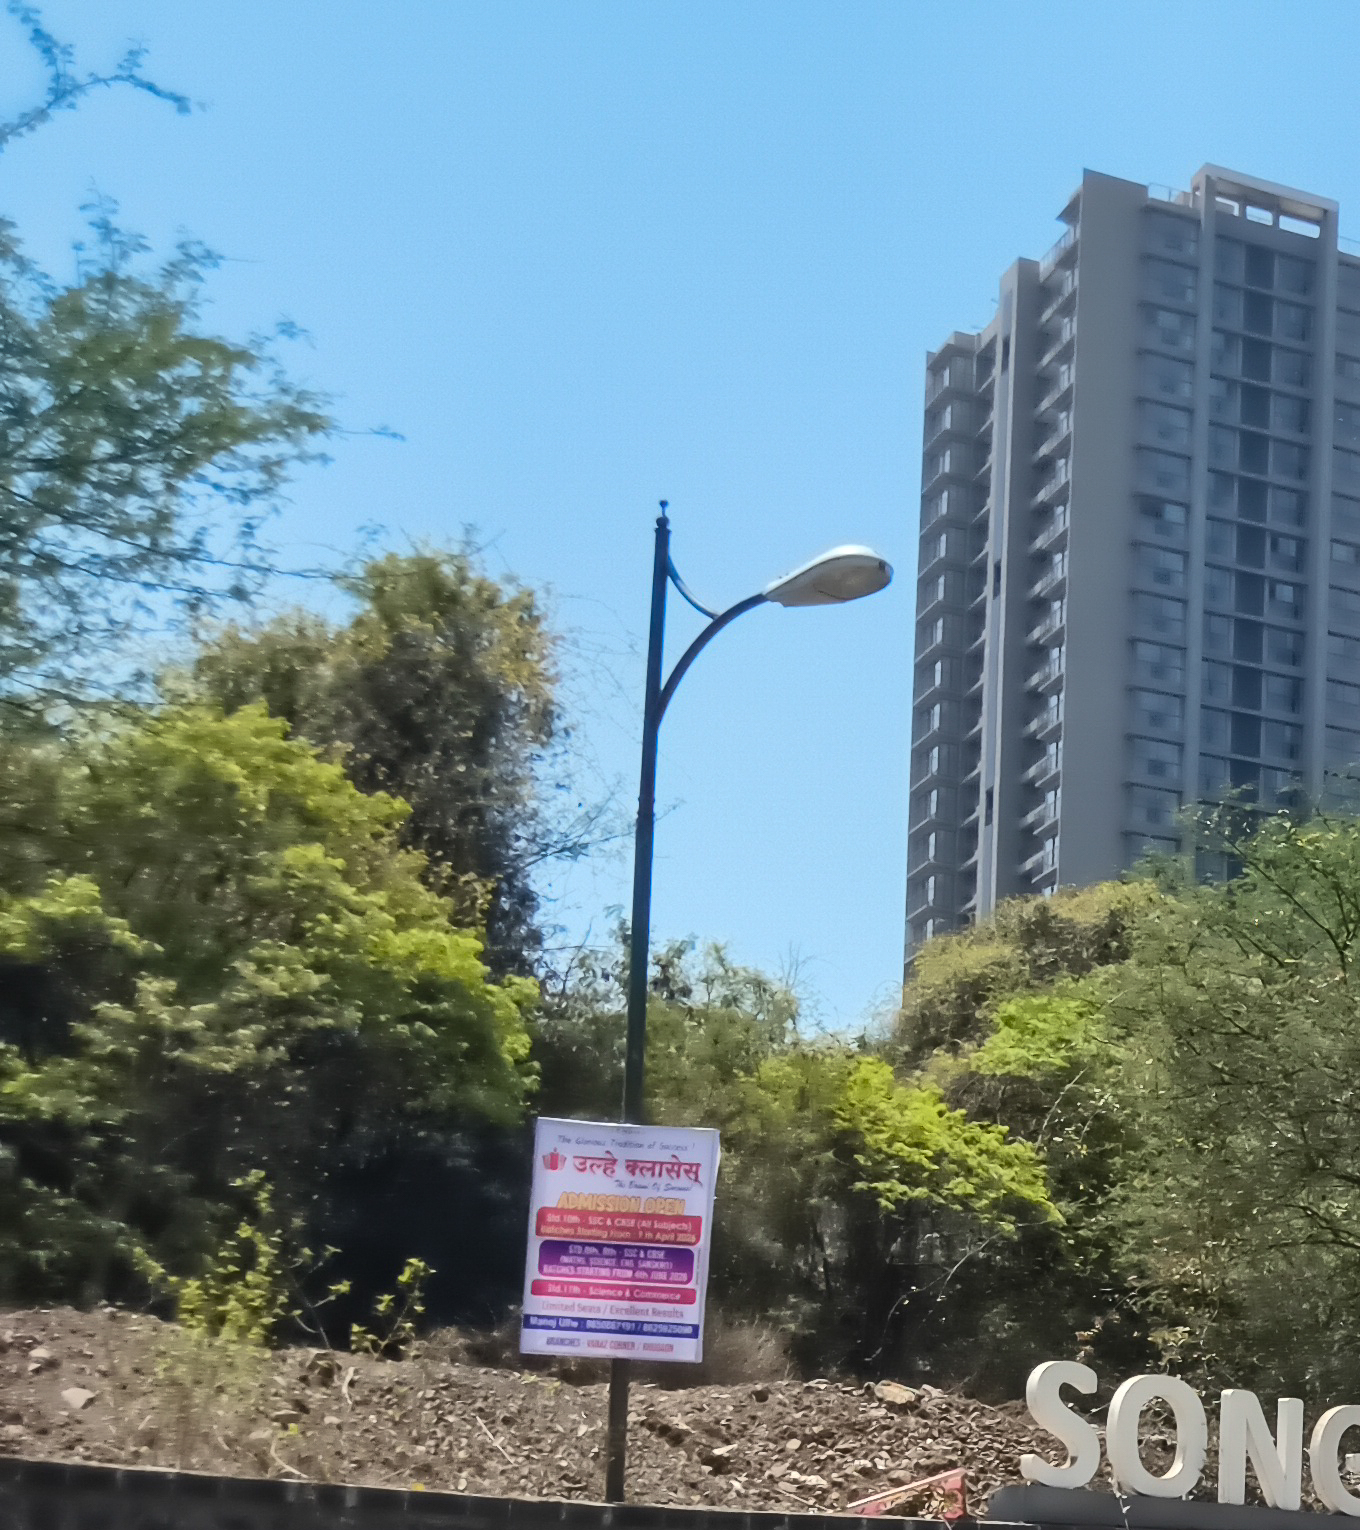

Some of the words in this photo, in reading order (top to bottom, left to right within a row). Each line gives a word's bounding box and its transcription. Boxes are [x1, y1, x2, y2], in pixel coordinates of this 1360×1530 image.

[557, 1135, 571, 1144] The
[573, 1150, 618, 1177] उल्हे
[625, 1154, 703, 1187] क्लासेस्
[557, 1191, 641, 1213] ADMISSION
[643, 1196, 686, 1215] OPEN
[589, 1286, 624, 1297] Science
[609, 1305, 650, 1317] Excellent
[652, 1308, 684, 1318] Results
